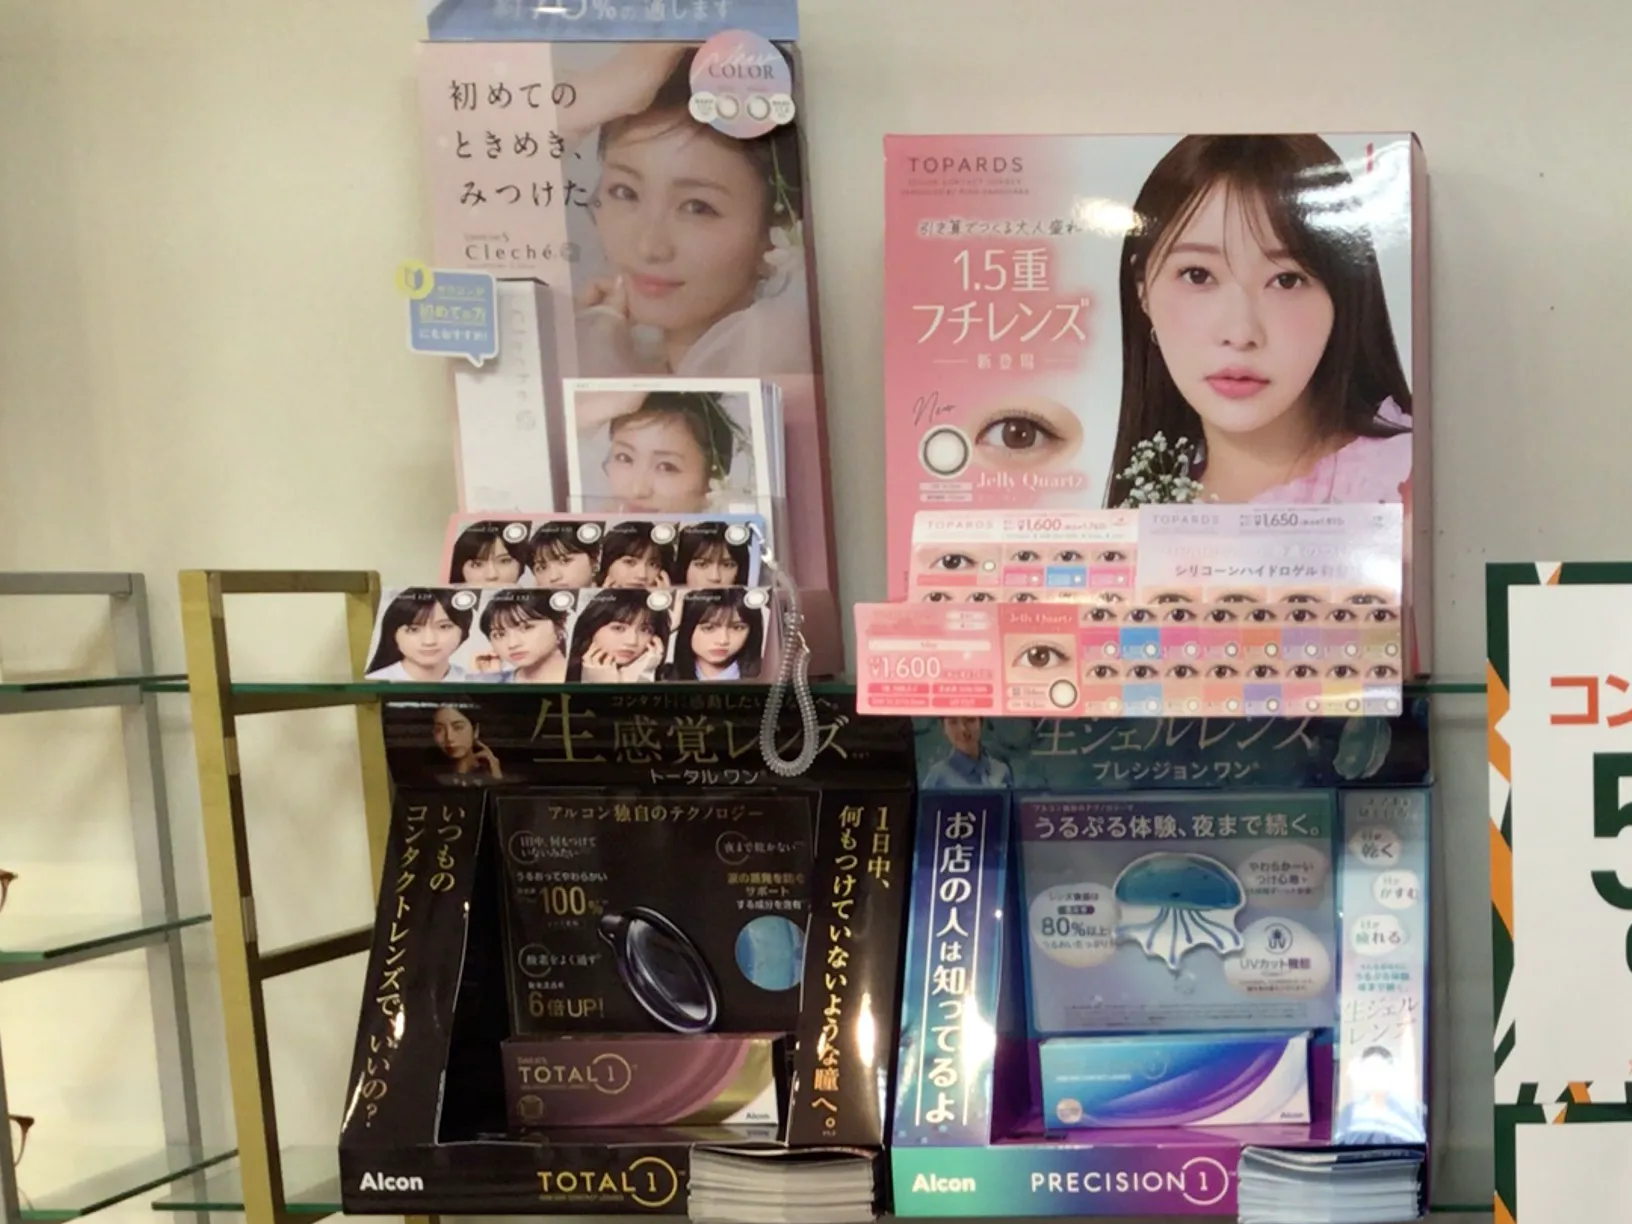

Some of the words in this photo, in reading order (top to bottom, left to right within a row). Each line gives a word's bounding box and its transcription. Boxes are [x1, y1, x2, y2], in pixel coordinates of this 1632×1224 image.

[708, 64, 775, 80] COLOR
[449, 80, 577, 110] 初めての
[456, 130, 583, 160] ときめき、
[908, 156, 1024, 174] TOPARDS
[460, 179, 602, 208] みつけた。
[952, 247, 1050, 294] 1.5重
[912, 299, 1090, 345] フチレンズ
[977, 353, 1035, 371] 新登場
[1021, 472, 1085, 491] Quartz
[548, 805, 764, 822] アルコン独自のテクノロジー
[1035, 813, 1320, 840] うるぷる体験、夜まで続く。
[429, 803, 467, 893] いつもの
[868, 804, 893, 889] 1日中、
[925, 810, 977, 1123] お店の人は知ってるよ
[518, 1064, 598, 1084] TOTAL
[359, 1171, 424, 1192] Alcon
[537, 1169, 637, 1194] TOTAL
[912, 1173, 976, 1192] Alcon
[1030, 1171, 1186, 1193] PRECISION
